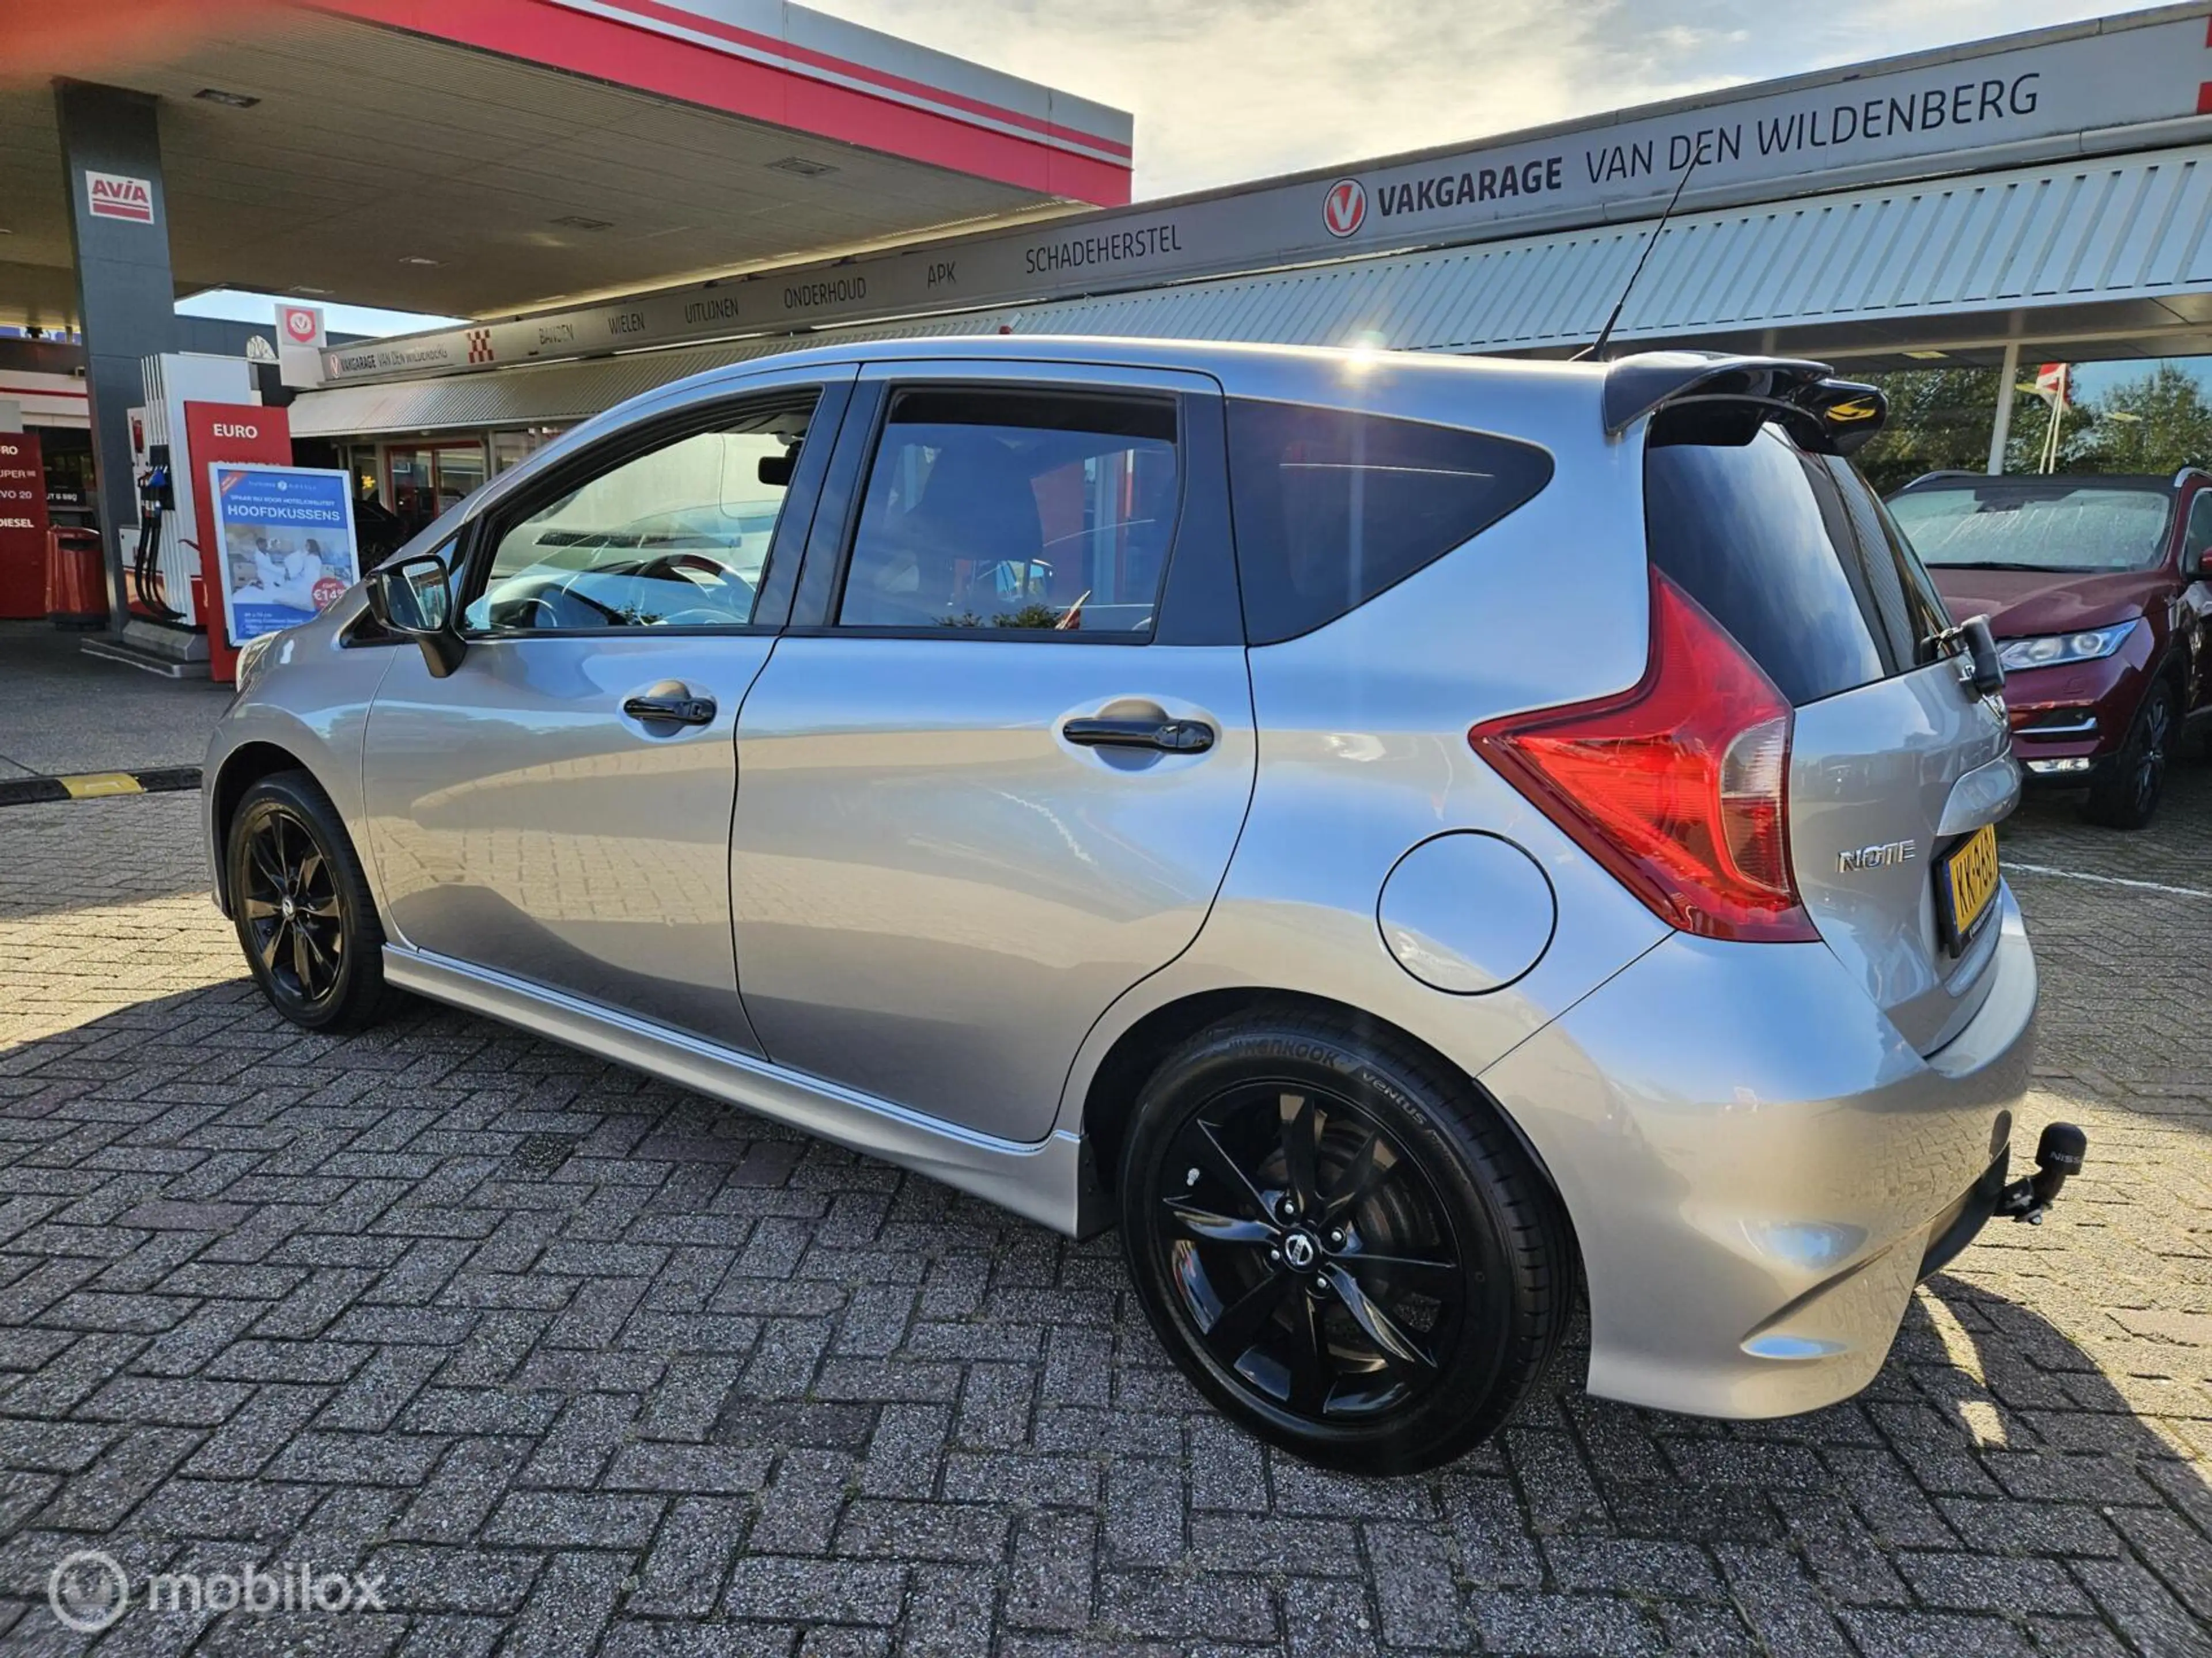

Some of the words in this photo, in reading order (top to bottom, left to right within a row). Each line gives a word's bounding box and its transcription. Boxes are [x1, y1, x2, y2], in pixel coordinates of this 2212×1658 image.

[1378, 157, 1563, 217] VAKGARAGE
[1586, 141, 1653, 183] VAN
[1669, 124, 1742, 171] DEN
[1758, 73, 2041, 157] WILDENBERG
[92, 180, 149, 203] AVIA
[1025, 225, 1181, 274] SCHADEHERSTEL
[927, 261, 957, 288] APK
[783, 277, 867, 309] ONDERHOUD
[684, 297, 738, 323] UITLIJNEN
[608, 313, 645, 335] WIELEN
[213, 424, 258, 439] EURO
[0, 445, 18, 456] RO
[228, 504, 340, 521] HOOFDKUSSENS
[1836, 839, 1916, 873] NOTE
